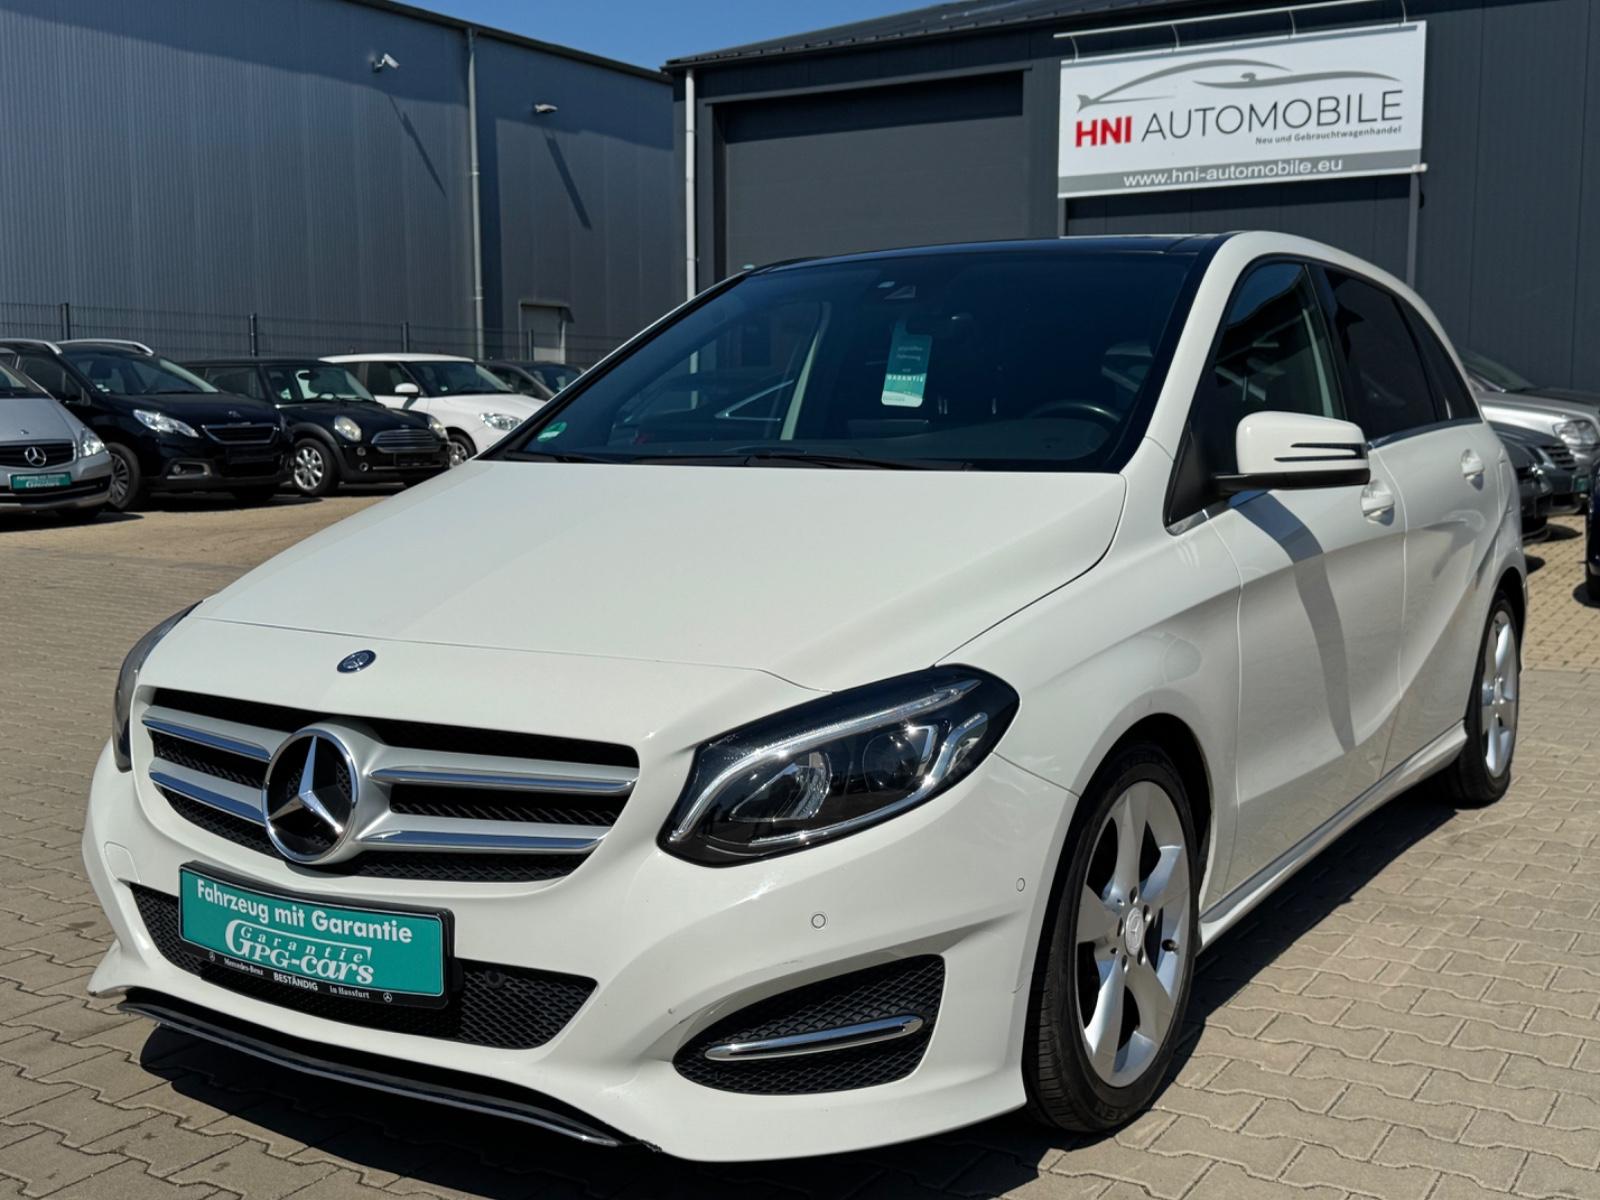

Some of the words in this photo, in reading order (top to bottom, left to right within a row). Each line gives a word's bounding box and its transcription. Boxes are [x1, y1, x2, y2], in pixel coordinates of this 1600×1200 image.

[1075, 116, 1133, 148] HNI
[1141, 90, 1404, 142] AUTOMOBILE
[1255, 136, 1274, 145] Neu
[1275, 134, 1293, 143] und
[1294, 126, 1402, 142] Gebrauchtwagenhandel
[1123, 158, 1343, 187] www.hni-automobile.eu
[197, 879, 269, 924] Fahrzeug
[275, 907, 305, 928] mit
[311, 911, 413, 944] Garantie
[225, 919, 374, 985] GPG-cars
[240, 925, 364, 964] Garantie
[273, 971, 319, 992] BESTÄNDIG
